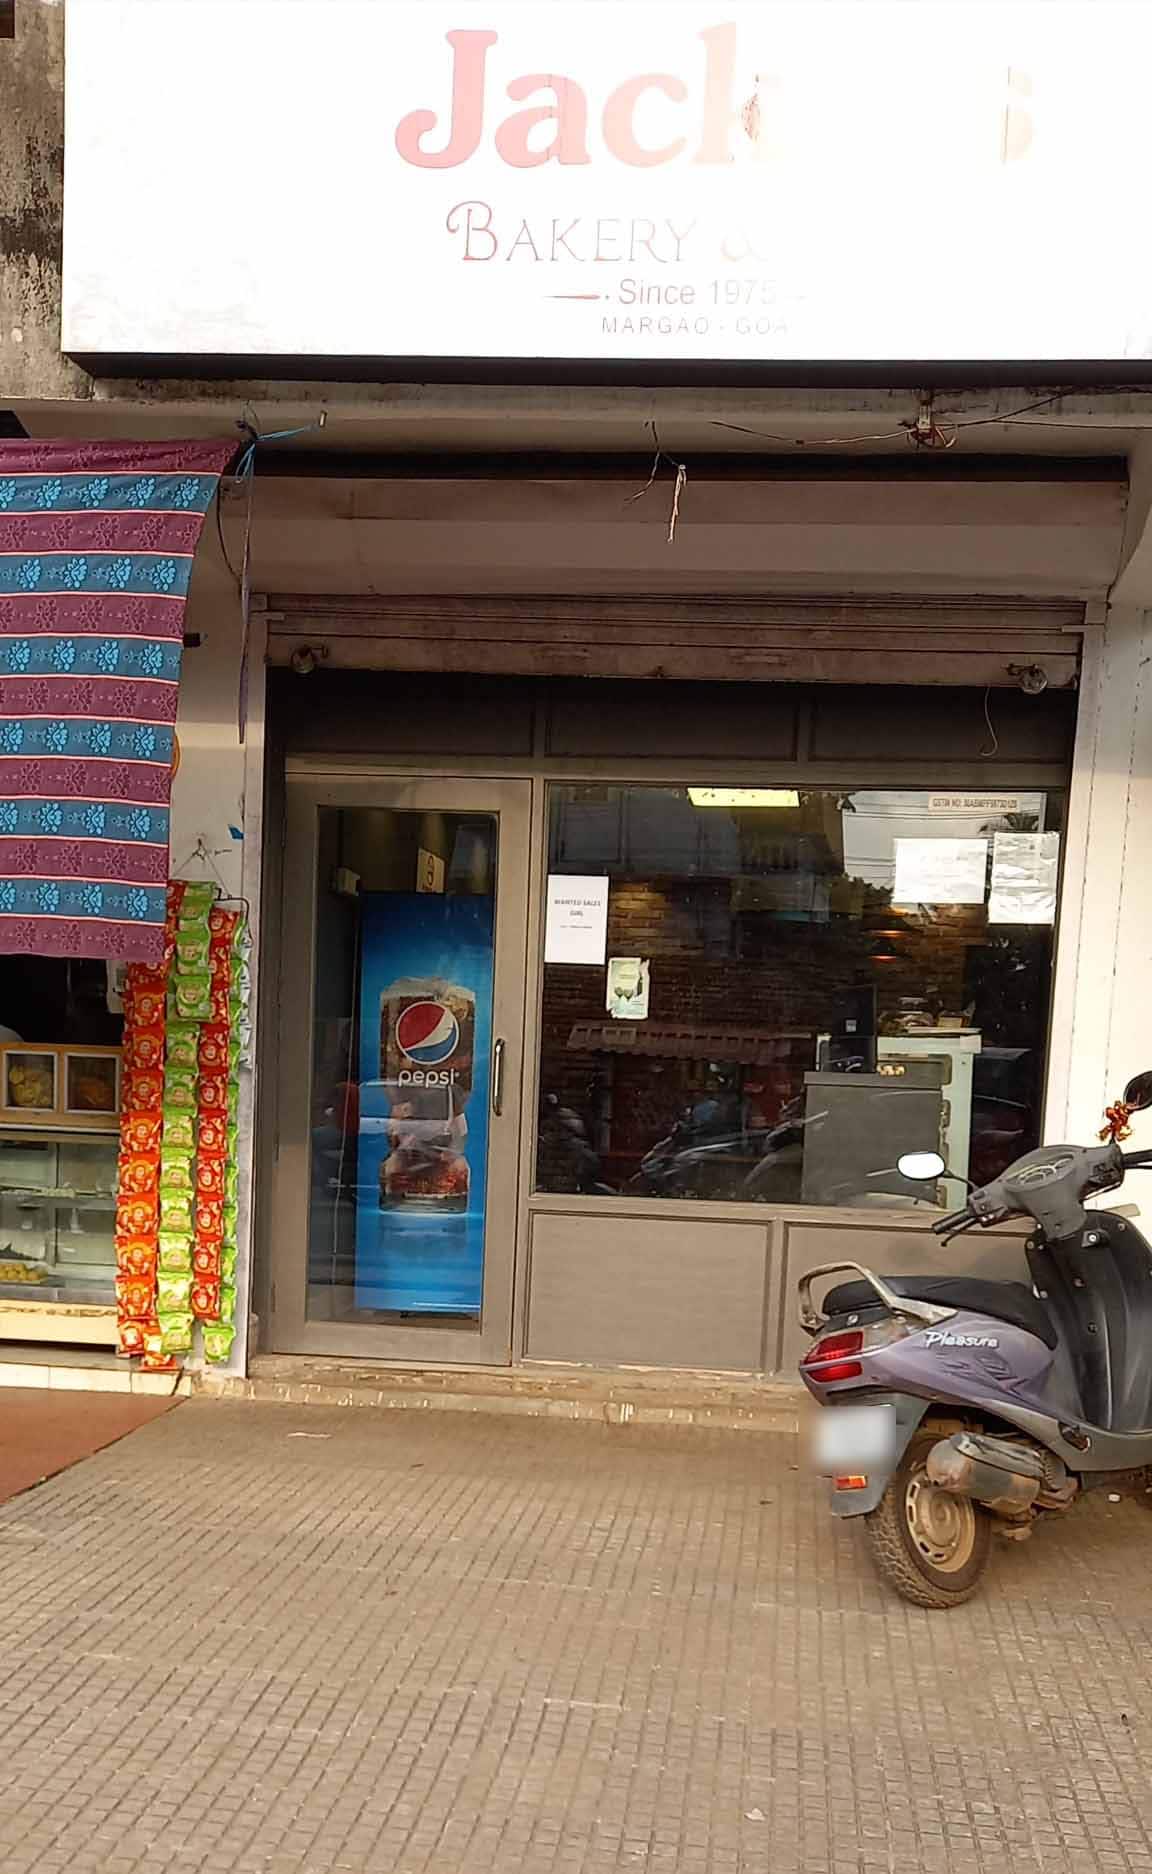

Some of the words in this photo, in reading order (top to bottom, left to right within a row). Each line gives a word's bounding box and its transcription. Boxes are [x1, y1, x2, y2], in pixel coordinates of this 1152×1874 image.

[446, 200, 698, 264] BAKERY
[618, 278, 697, 305] Since
[709, 279, 777, 305] 1975
[601, 316, 710, 336] MARGAO
[735, 316, 789, 336] GOA
[398, 1068, 455, 1088] pepsi
[926, 1331, 999, 1349] Pleasure
